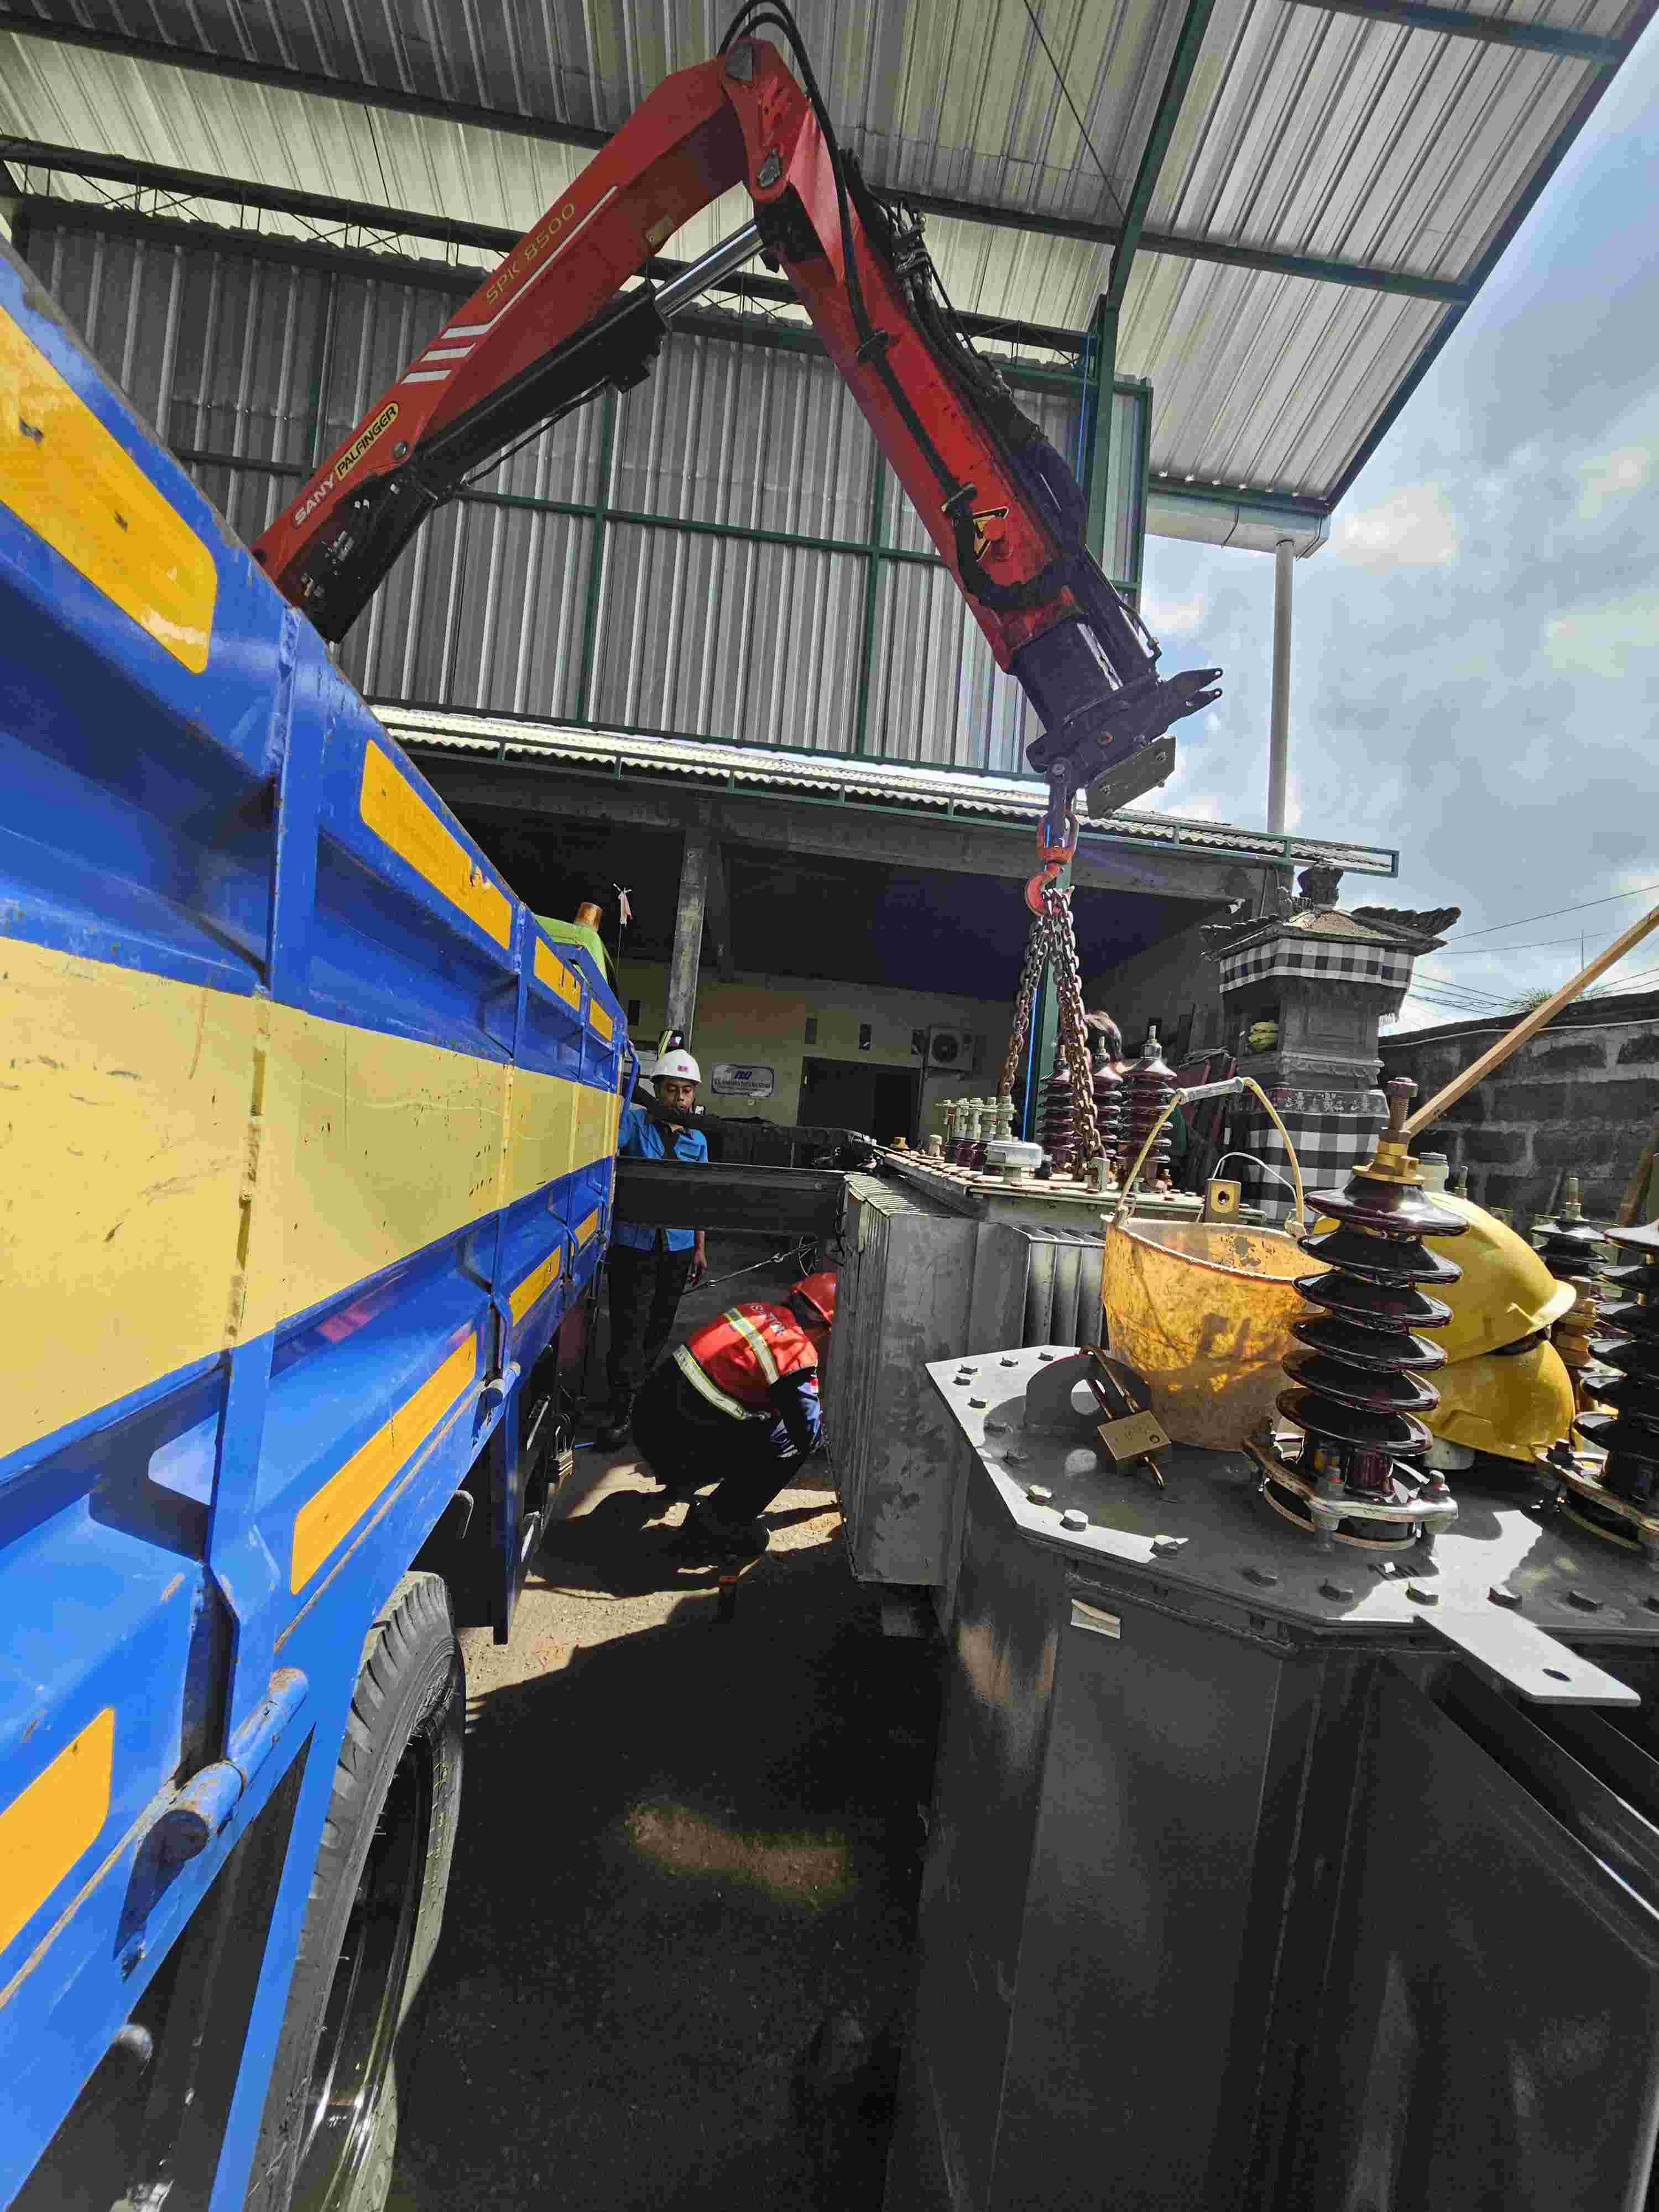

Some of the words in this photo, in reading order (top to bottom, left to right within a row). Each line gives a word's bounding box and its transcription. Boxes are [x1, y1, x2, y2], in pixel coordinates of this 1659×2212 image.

[486, 263, 521, 305] SPK
[524, 203, 575, 260] 8500
[295, 473, 335, 525] SANY
[338, 406, 398, 476] PALFINGER
